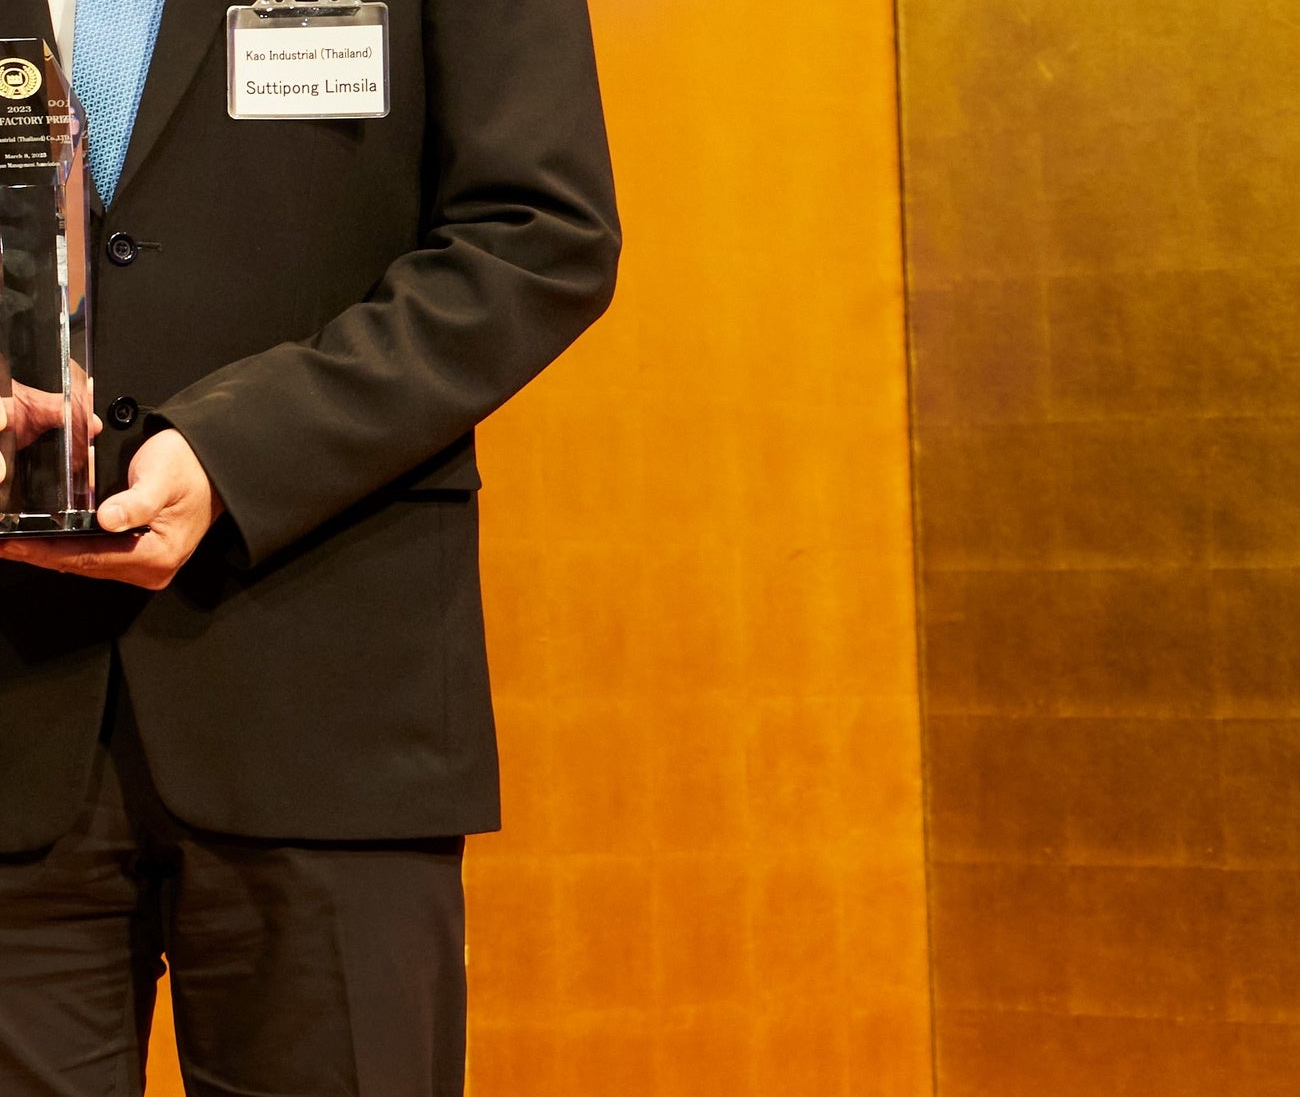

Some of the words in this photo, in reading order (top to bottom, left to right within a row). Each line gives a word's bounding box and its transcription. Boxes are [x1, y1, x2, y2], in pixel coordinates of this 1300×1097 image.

[246, 50, 266, 61] Kao
[269, 49, 318, 61] Industrial
[321, 46, 373, 60] (Thailand)
[246, 80, 319, 97] Suttipong
[325, 78, 377, 94] Limsila
[7, 105, 32, 114] 2023
[0, 115, 45, 127] FACTORY
